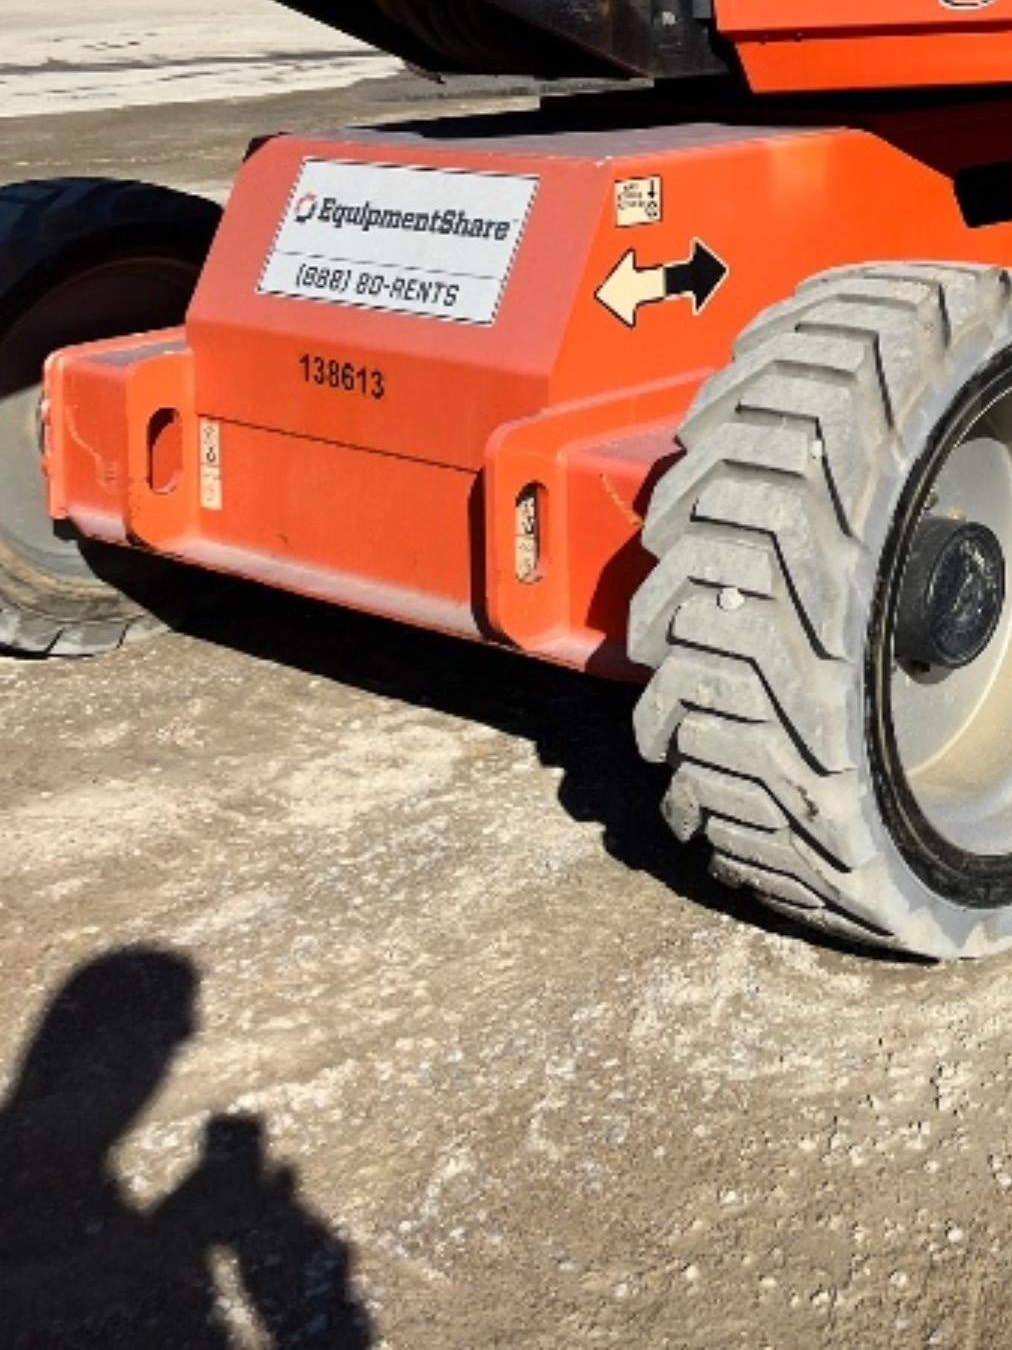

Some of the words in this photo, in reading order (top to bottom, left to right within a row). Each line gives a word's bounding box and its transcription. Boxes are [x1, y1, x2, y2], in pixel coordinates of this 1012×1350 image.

[316, 196, 512, 242] EquipmentShare
[295, 262, 352, 294] (888)
[355, 271, 460, 307] 80-RENTS
[299, 353, 386, 400] 138613
